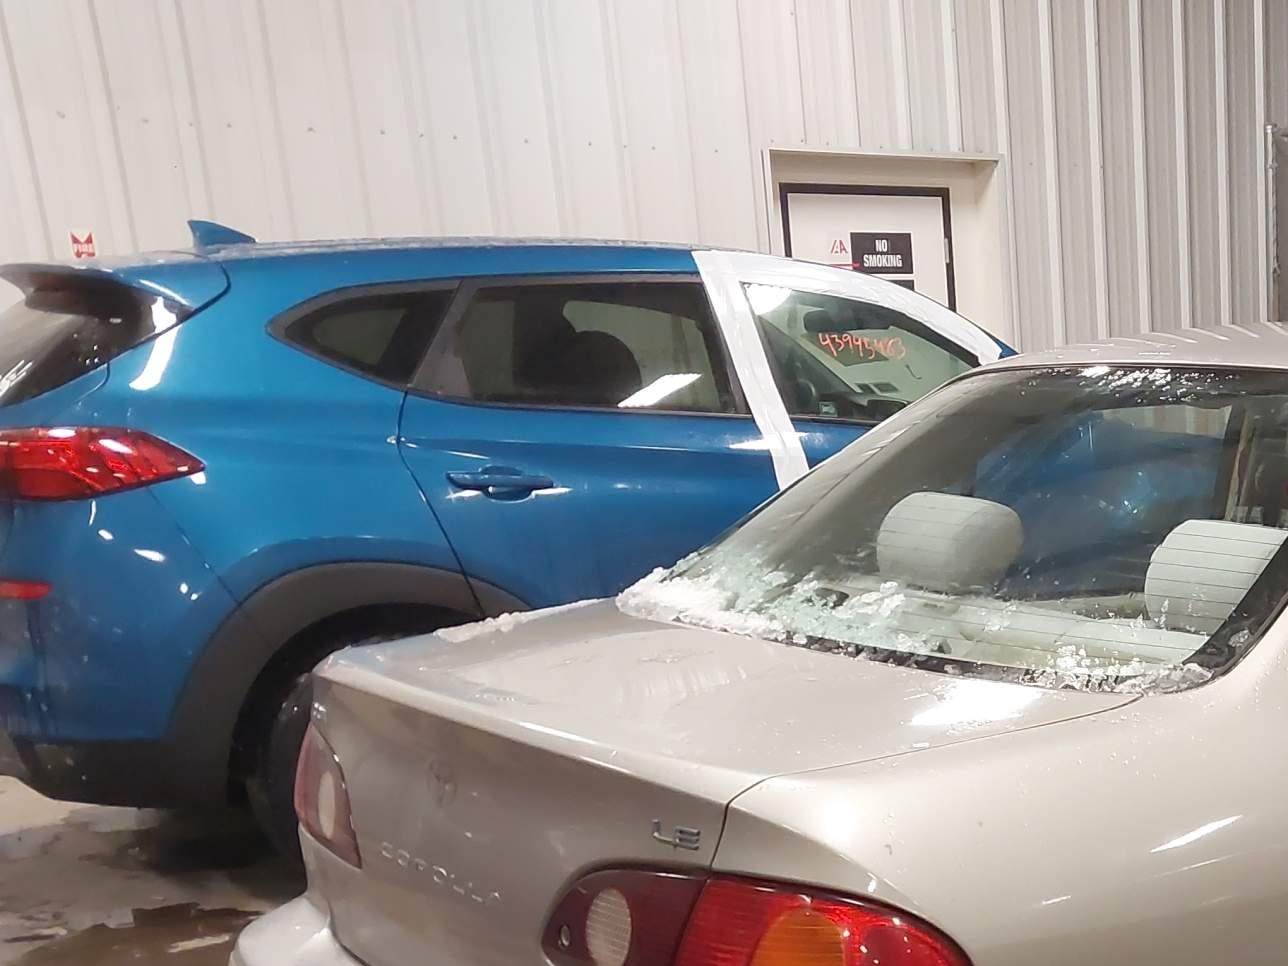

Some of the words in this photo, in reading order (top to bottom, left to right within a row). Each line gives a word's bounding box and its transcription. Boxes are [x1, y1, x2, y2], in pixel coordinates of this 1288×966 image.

[875, 239, 888, 252] NO
[863, 254, 903, 268] SMOKING
[651, 818, 701, 851] LE
